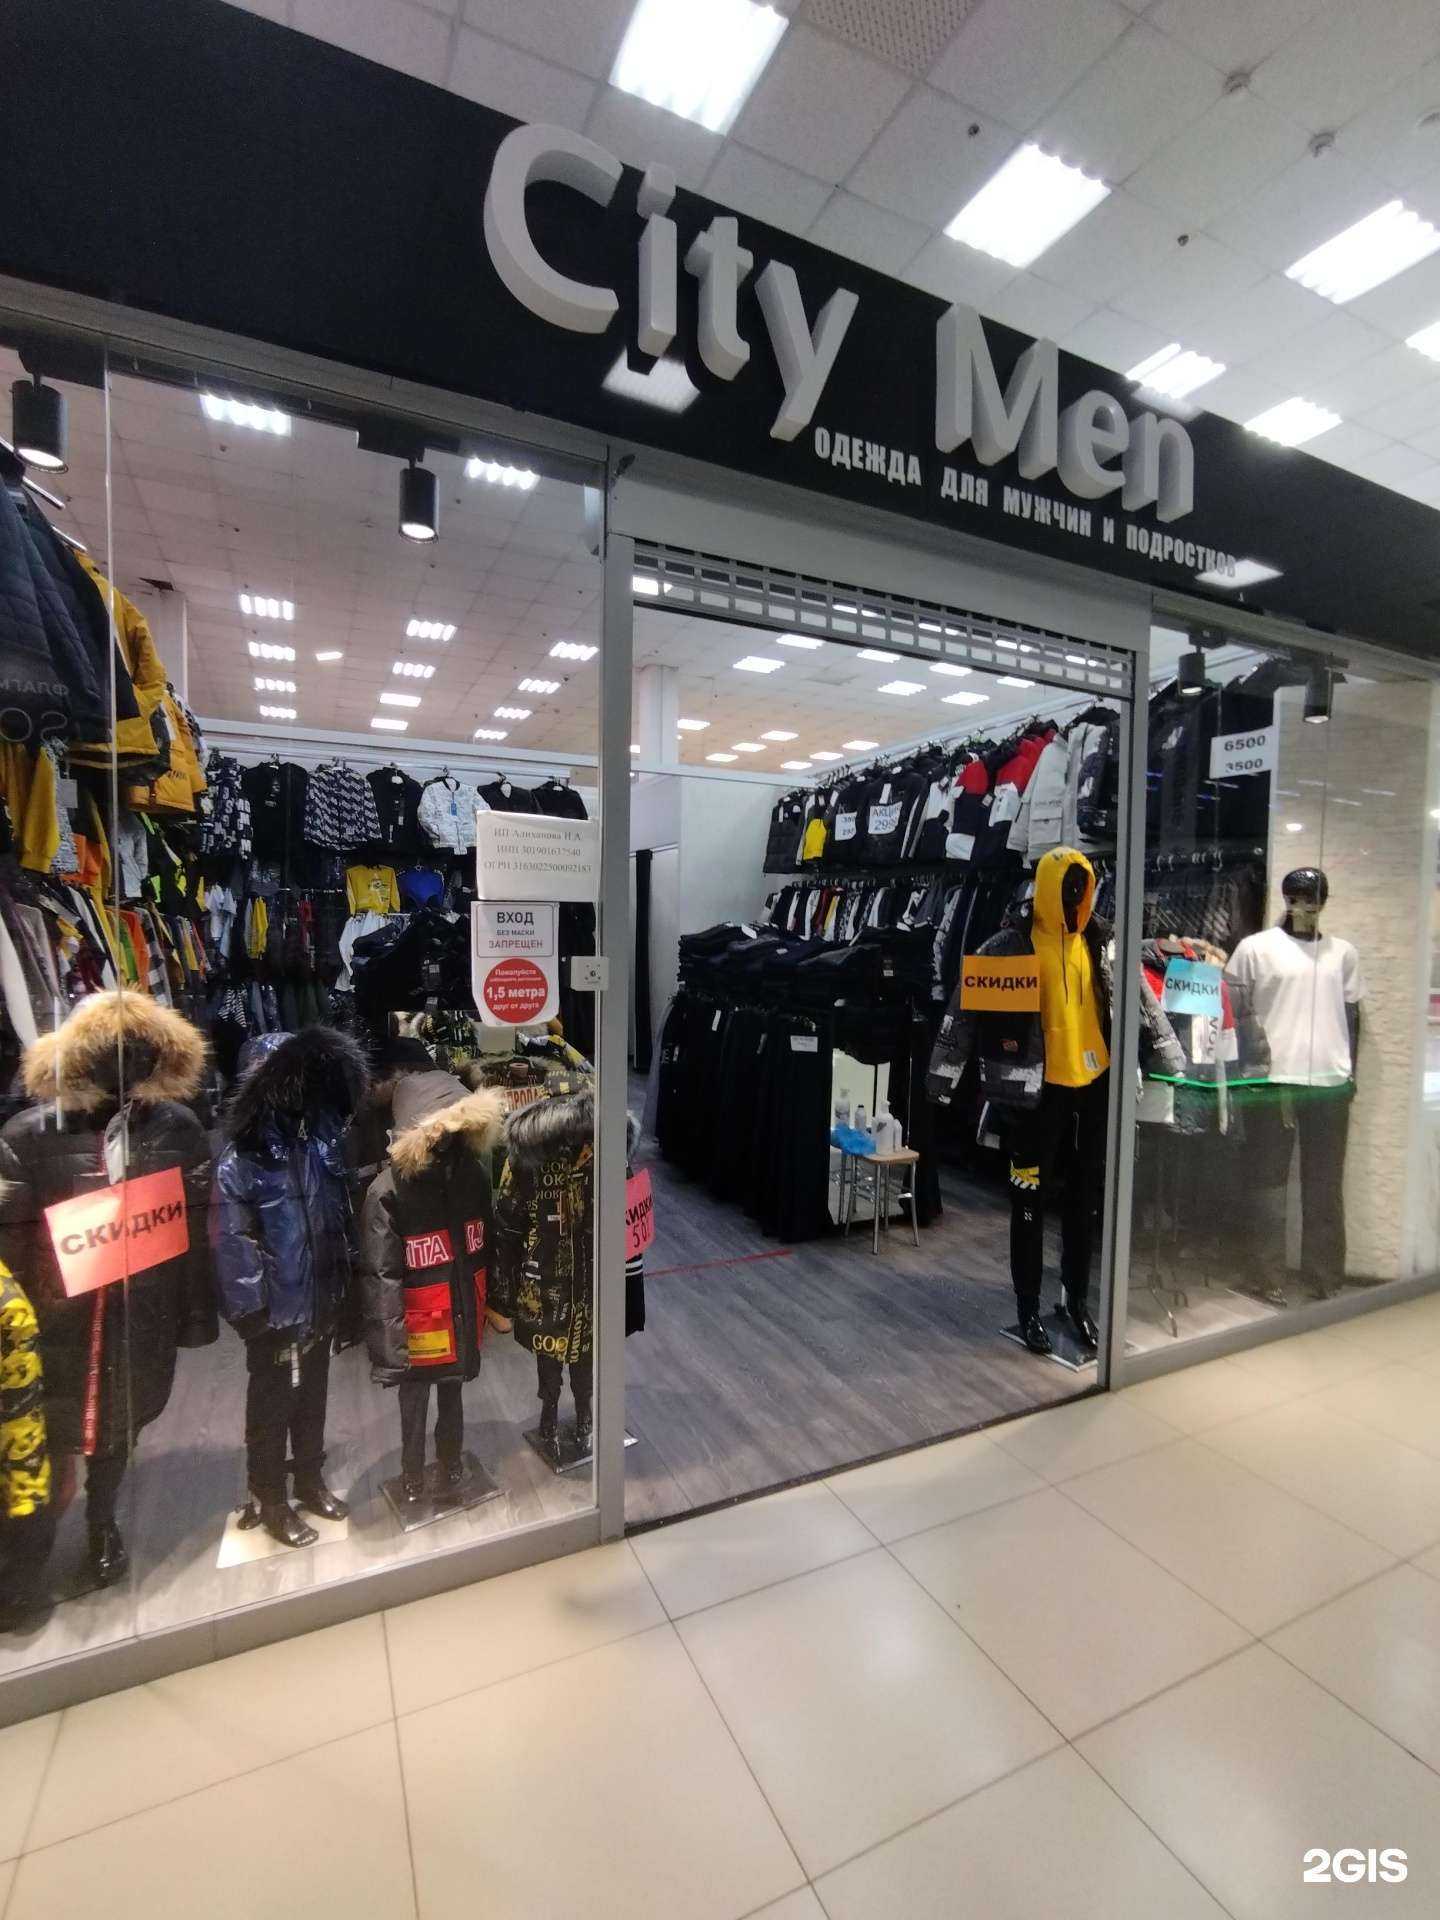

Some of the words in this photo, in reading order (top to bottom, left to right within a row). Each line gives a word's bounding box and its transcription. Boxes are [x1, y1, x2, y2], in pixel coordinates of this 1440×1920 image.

[484, 123, 860, 441] City
[936, 302, 1194, 523] Men
[814, 427, 922, 487] ОДЕЖДА
[940, 466, 989, 507] ДЛЯ
[1003, 485, 1092, 538] МУЖЧИН
[1103, 516, 1115, 545] И
[1126, 523, 1238, 578] ПОДРОСТКОВ
[1224, 735, 1266, 752] 6500
[1225, 758, 1264, 774] 3500
[497, 912, 534, 925] ВХОД
[488, 940, 543, 949] ЗАПРЕЩЕН
[964, 975, 1038, 991] СКИДКИ
[1165, 977, 1219, 997] СКИДКИ
[487, 986, 505, 1001] 1,5
[508, 987, 546, 1001] метра
[60, 1201, 183, 1255] СКИДКИ
